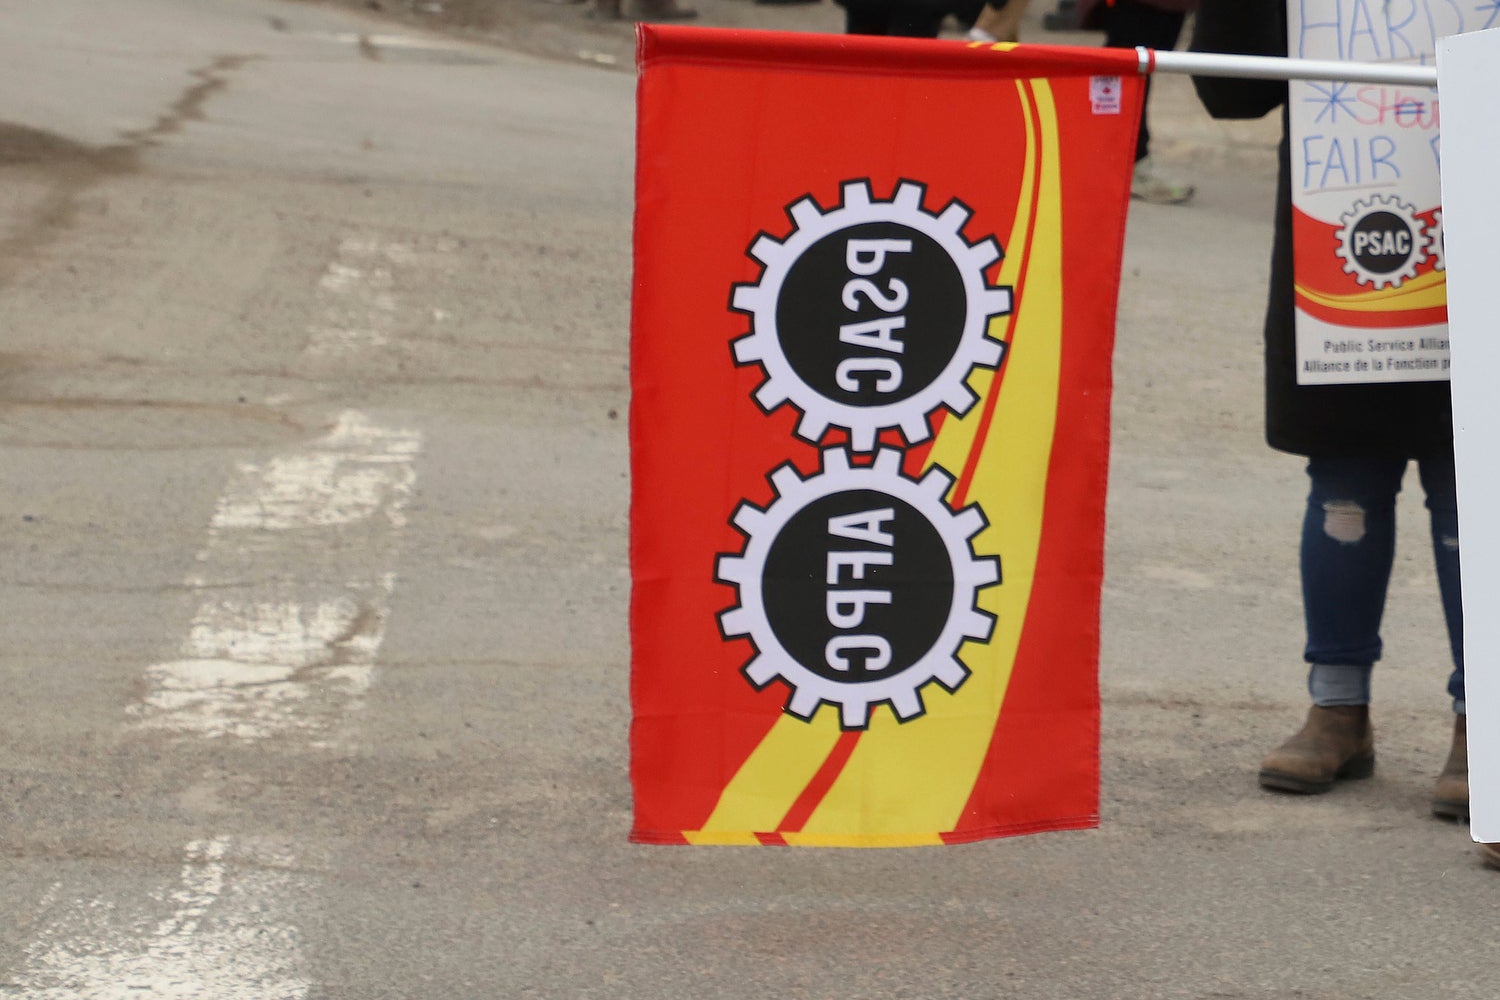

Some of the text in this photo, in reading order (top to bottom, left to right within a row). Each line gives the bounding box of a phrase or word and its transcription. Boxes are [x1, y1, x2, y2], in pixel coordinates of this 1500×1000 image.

[1302, 134, 1401, 189] FAIR
[1353, 229, 1411, 257] PSAC
[1324, 339, 1364, 354] Public
[1367, 338, 1415, 352] Service
[1303, 360, 1350, 373] Alliance
[1353, 359, 1369, 372] de
[1371, 358, 1383, 371] la
[1386, 357, 1438, 371] Fonction
